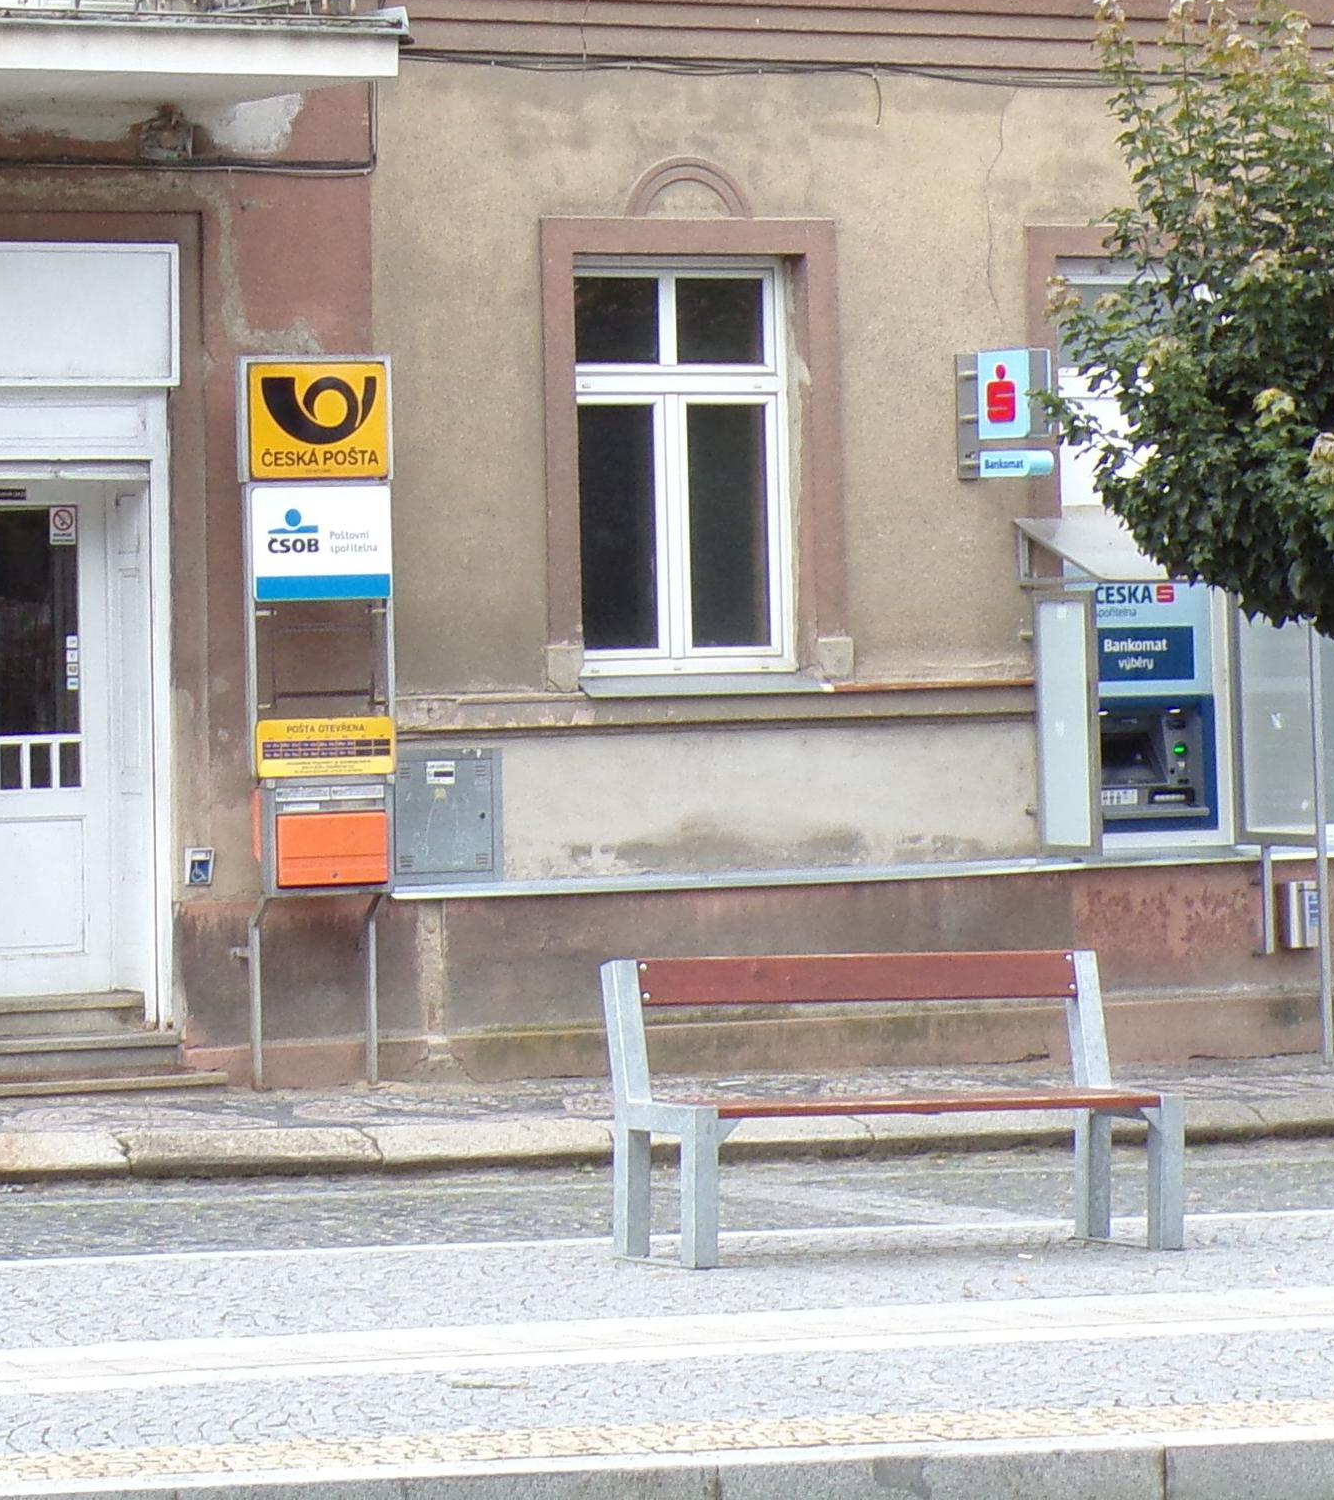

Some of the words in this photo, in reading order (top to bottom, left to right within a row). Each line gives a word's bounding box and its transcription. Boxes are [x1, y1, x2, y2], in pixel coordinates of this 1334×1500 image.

[261, 448, 319, 467] ČESKÁ
[323, 447, 379, 465] POŠTA
[984, 459, 1024, 470] Bankomat
[329, 530, 370, 540] Poštovní
[267, 537, 320, 554] ČSOB
[1104, 638, 1168, 653] Bankomat
[1118, 656, 1154, 670] výběry
